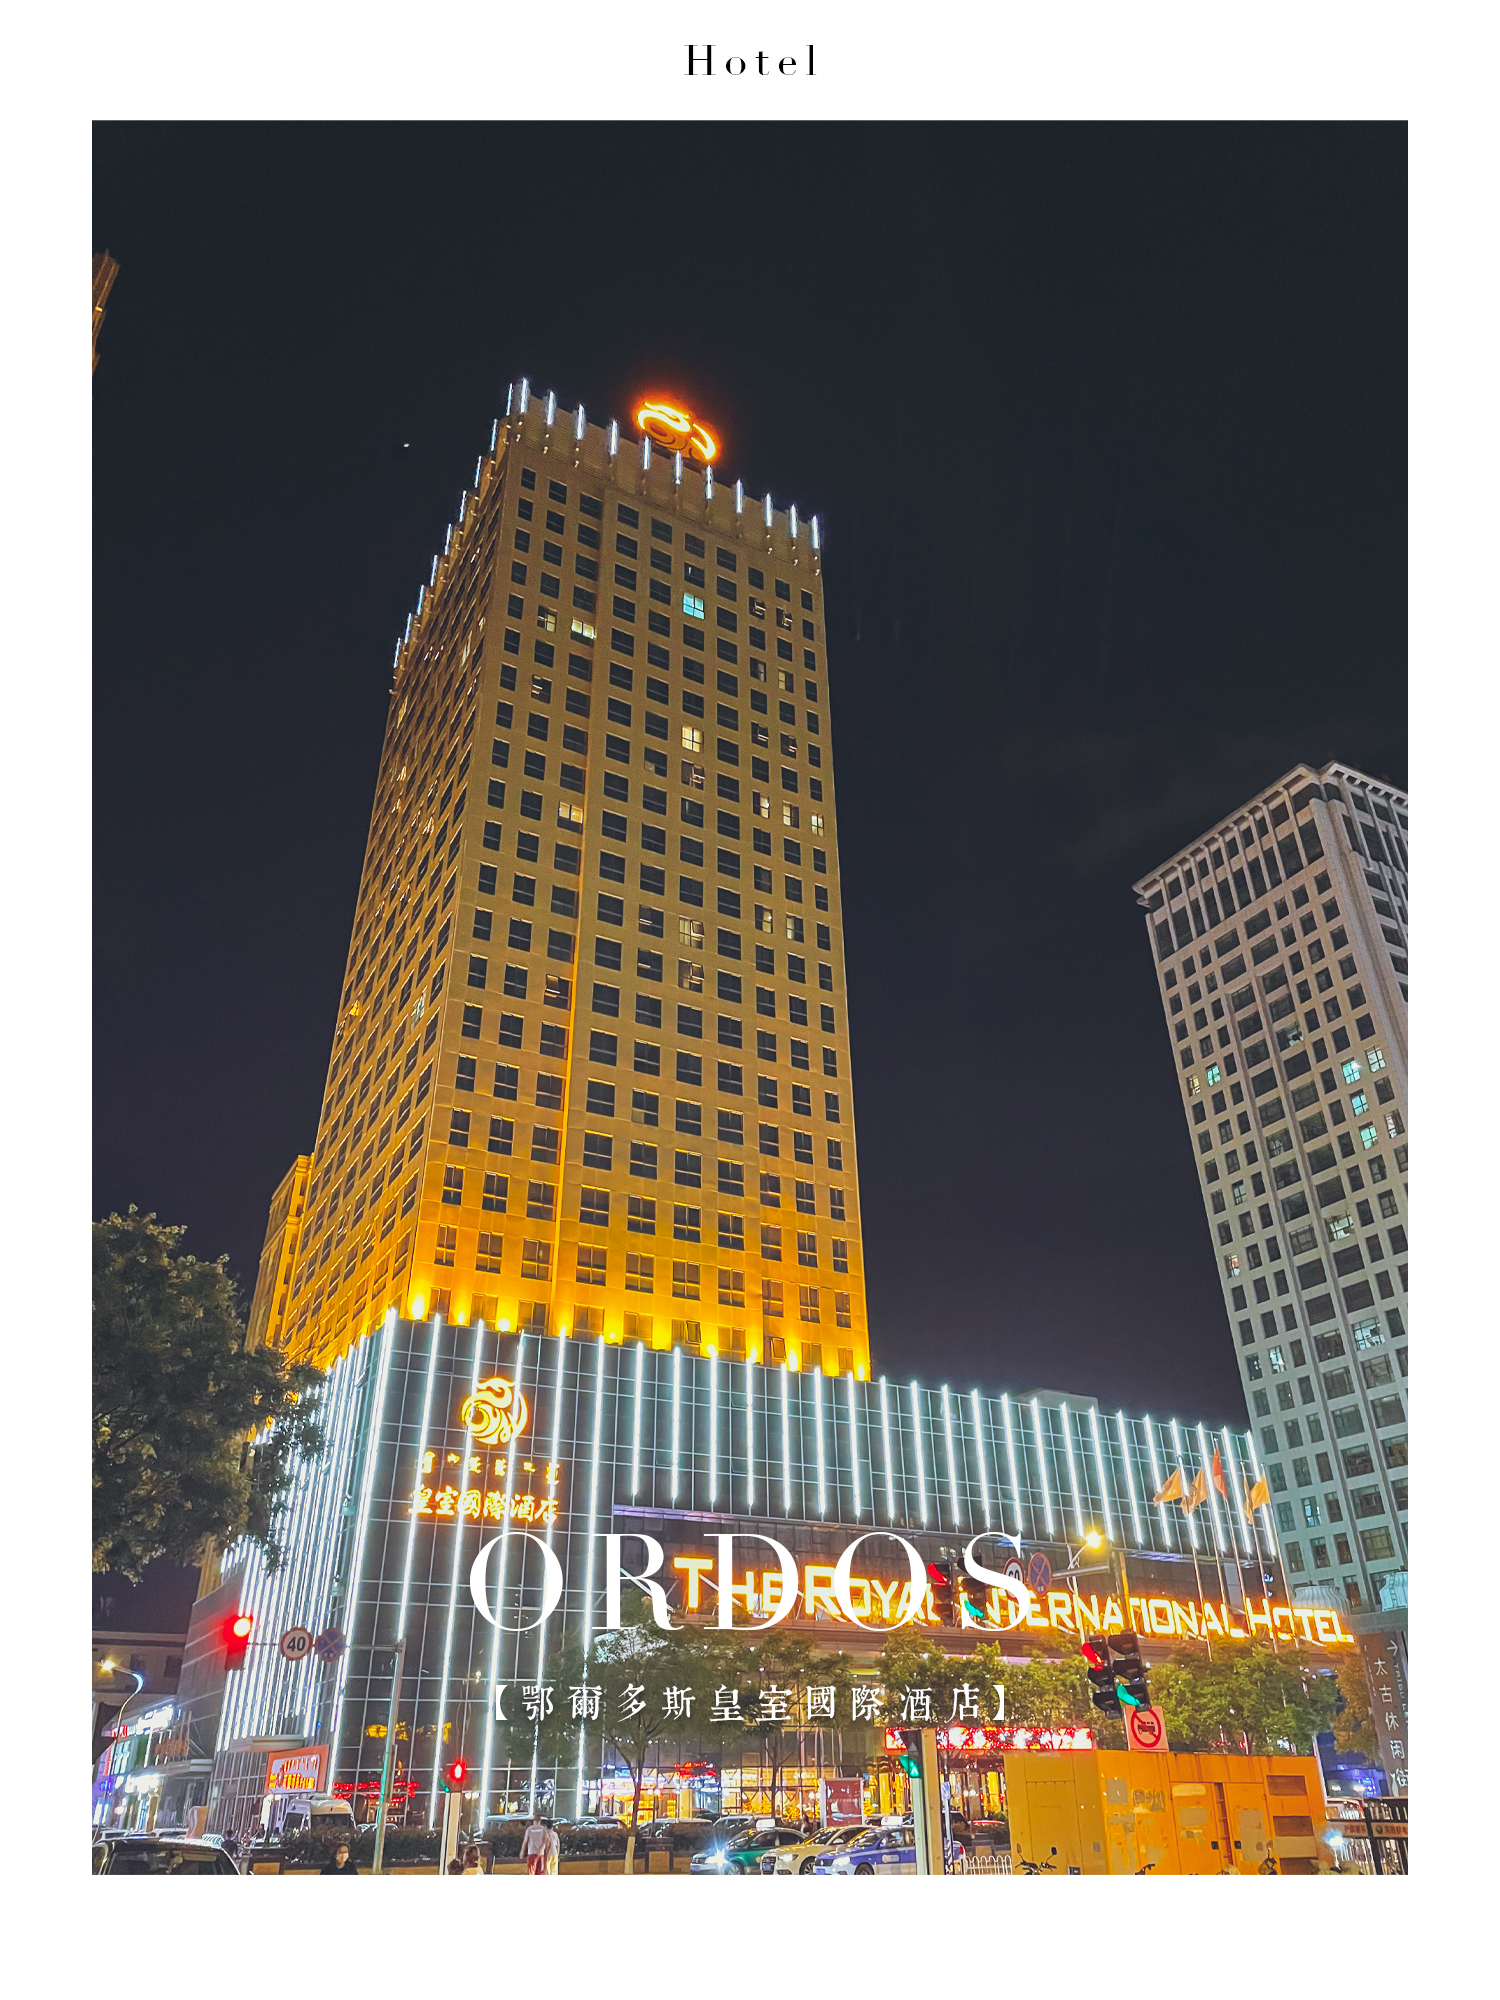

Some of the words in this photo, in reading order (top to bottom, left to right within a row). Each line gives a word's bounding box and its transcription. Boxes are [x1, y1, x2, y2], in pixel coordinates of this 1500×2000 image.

[408, 1484, 560, 1525] 皇室國際酒店
[673, 1556, 785, 1615] THE
[804, 1565, 944, 1621] ROYAL
[1246, 1597, 1356, 1644] HOTEL
[286, 1636, 306, 1652] 40
